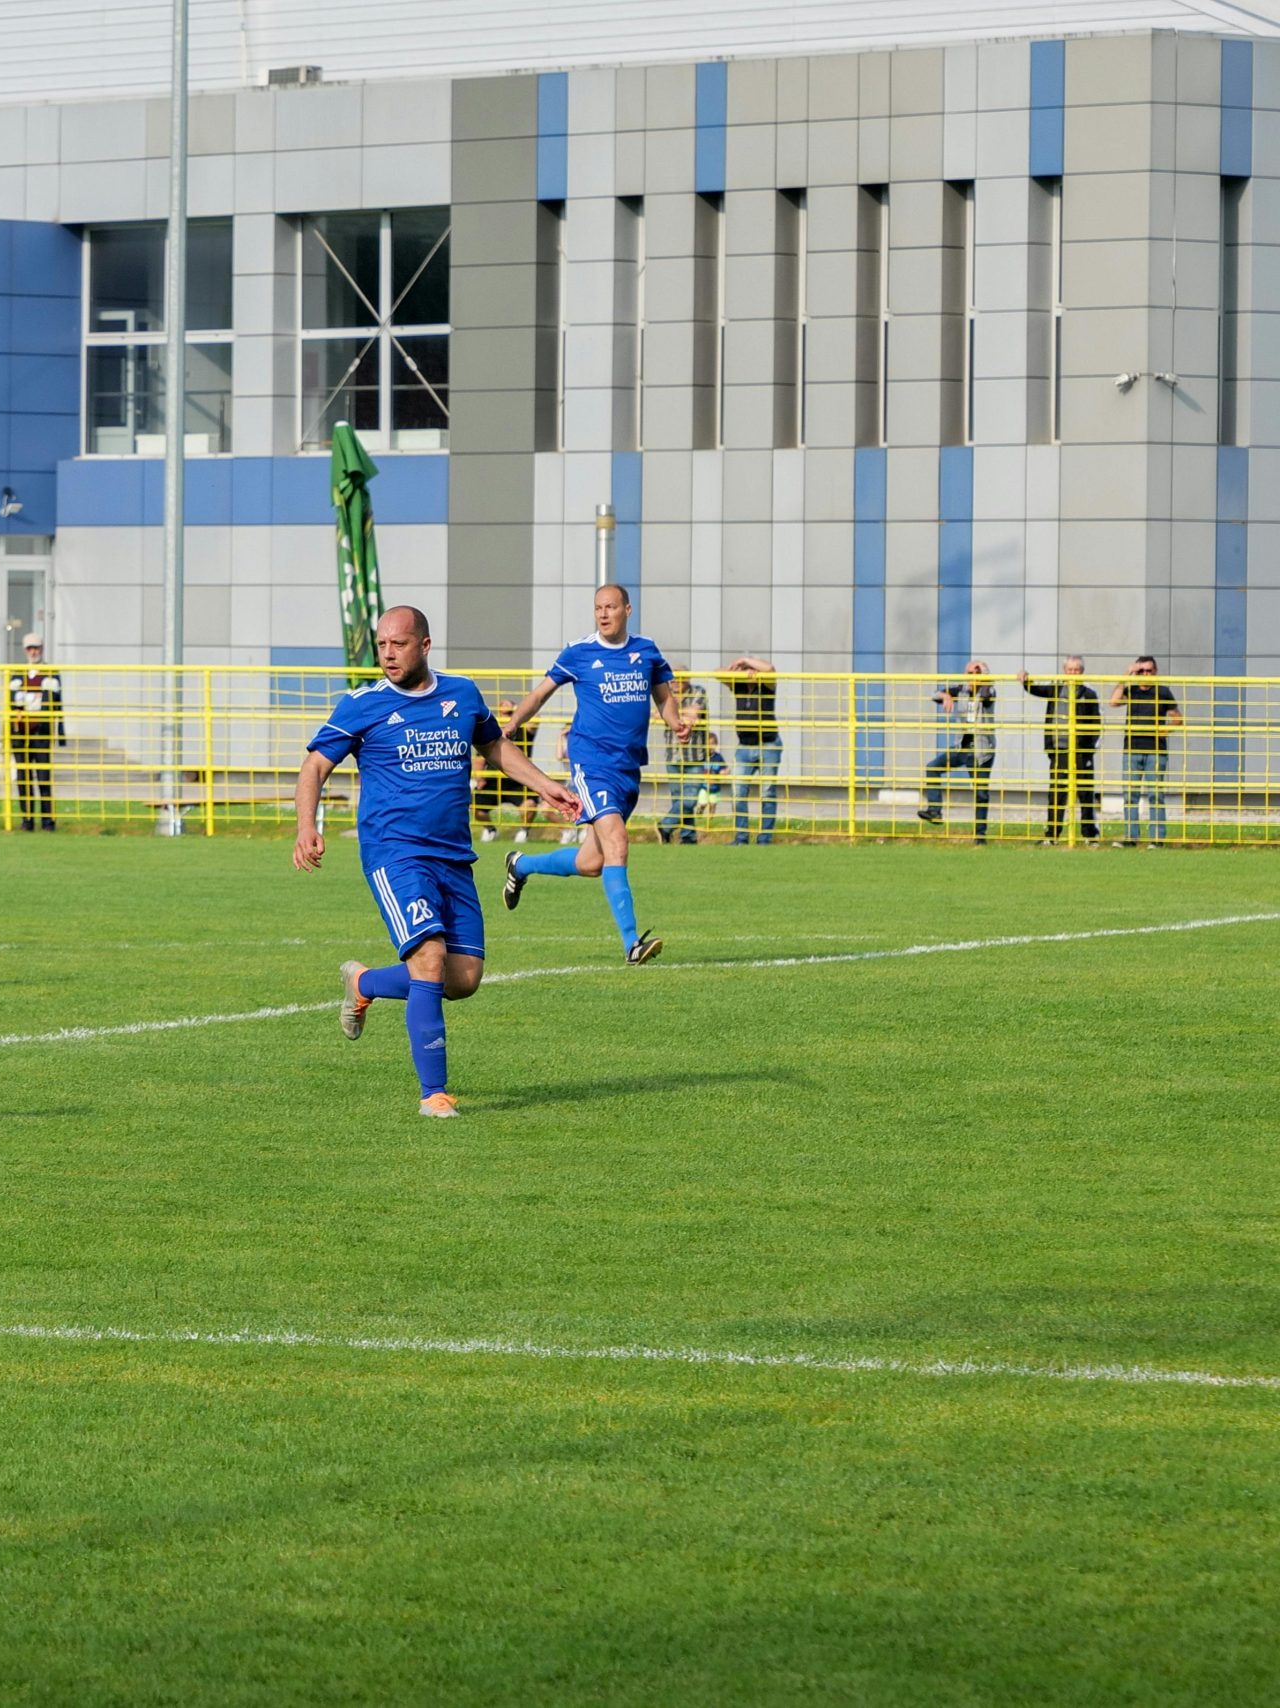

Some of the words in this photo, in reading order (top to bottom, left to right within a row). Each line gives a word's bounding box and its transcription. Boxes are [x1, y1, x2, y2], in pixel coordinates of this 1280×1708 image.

[604, 670, 643, 682] Pizzeria
[599, 680, 648, 694] PALERMO
[603, 692, 647, 704] Garešnica
[404, 727, 460, 743] Pizzeria
[397, 741, 468, 759] PALERMO
[401, 757, 463, 773] Garešnica
[597, 790, 608, 806] 7
[406, 898, 434, 926] 28
